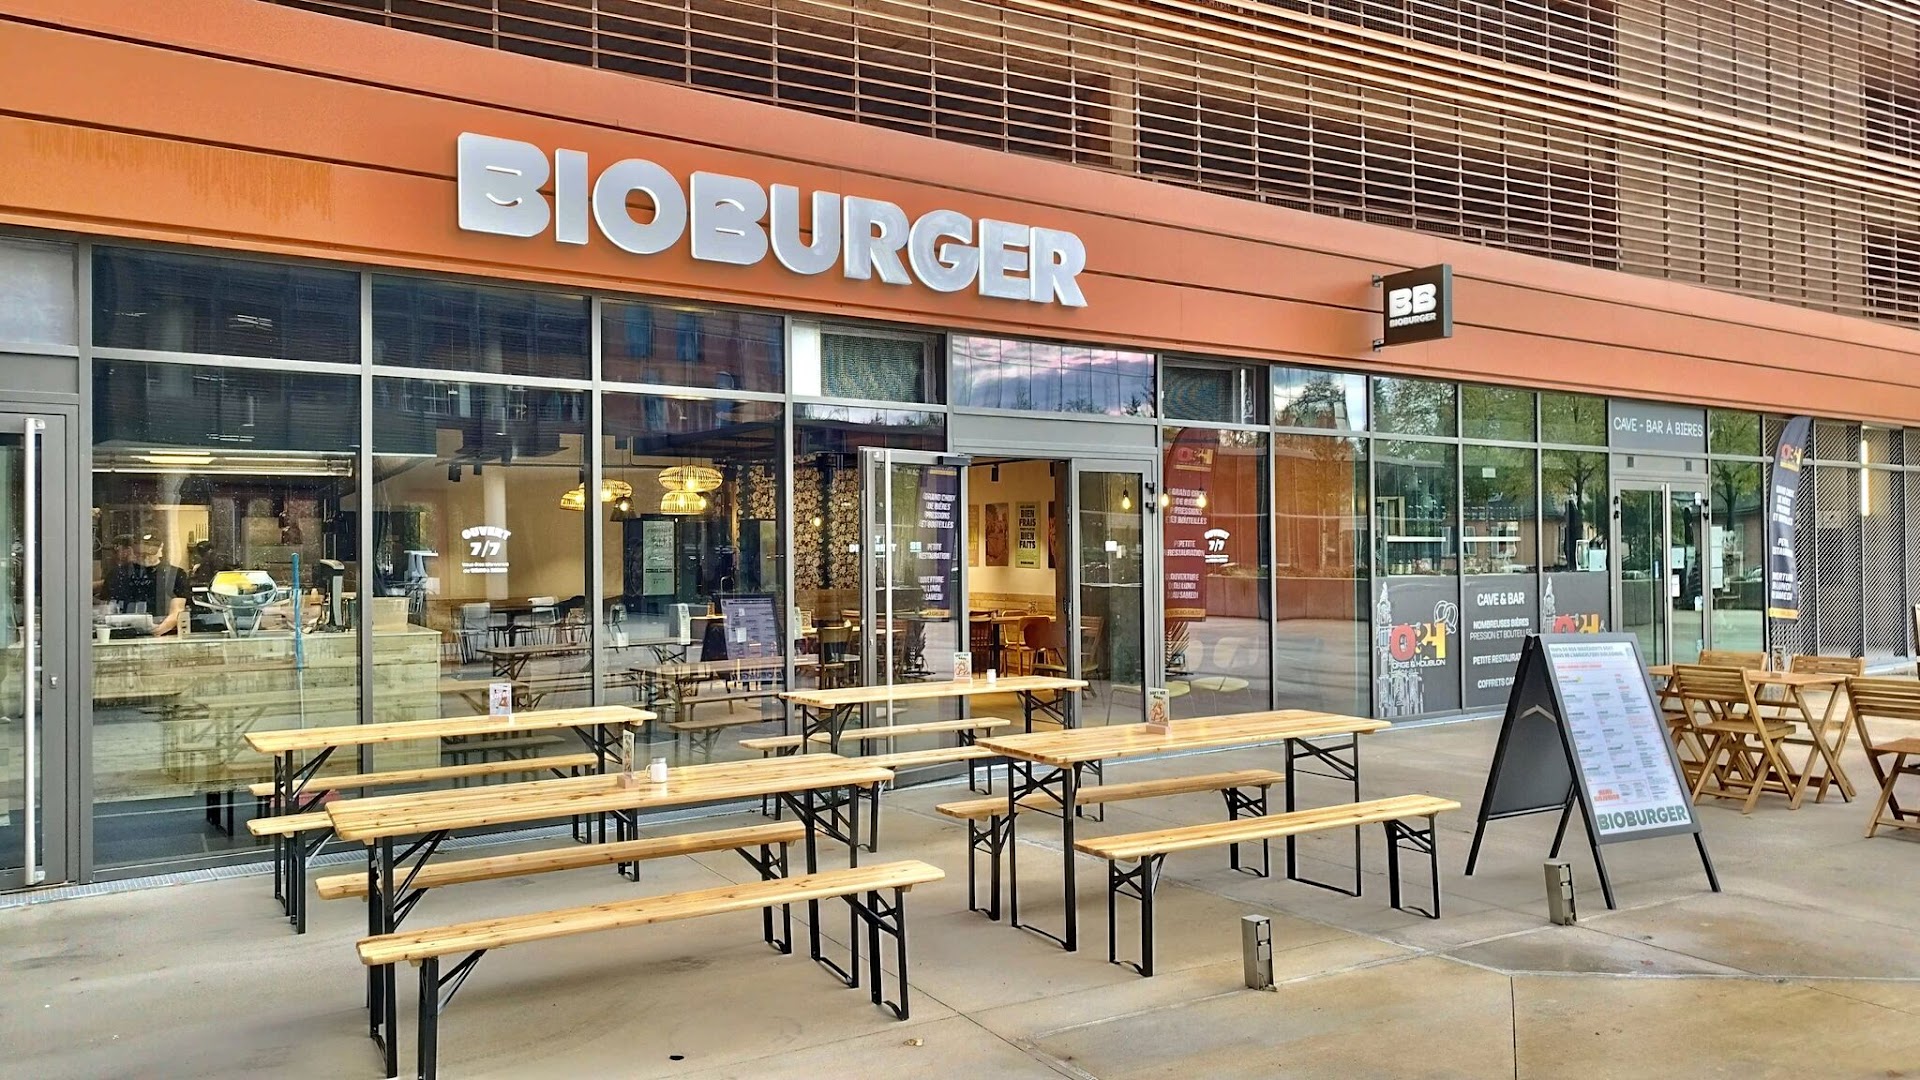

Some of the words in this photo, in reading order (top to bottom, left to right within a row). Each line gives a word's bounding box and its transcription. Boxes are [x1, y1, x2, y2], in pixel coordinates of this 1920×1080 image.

[456, 131, 1088, 308] BIOBURGER
[1388, 283, 1437, 318] BB
[1388, 312, 1437, 328] BIOBURGER
[1613, 417, 1638, 432] CAVE
[1646, 419, 1664, 434] BAR
[461, 526, 512, 540] OUVERT
[470, 540, 501, 558] 7/7
[1208, 539, 1225, 552] 7/7
[1477, 592, 1500, 606] CAVE
[1500, 593, 1507, 605] &
[1508, 591, 1525, 605] BAR
[1473, 619, 1511, 629] NOMBREUSES
[1470, 631, 1496, 640] PRESSION
[1496, 630, 1503, 639] ET
[1472, 655, 1491, 665] PETITE
[1491, 653, 1522, 664] RESTAURAT
[1477, 677, 1505, 689] COFFRETS
[1597, 805, 1687, 830] BIOBURGER
